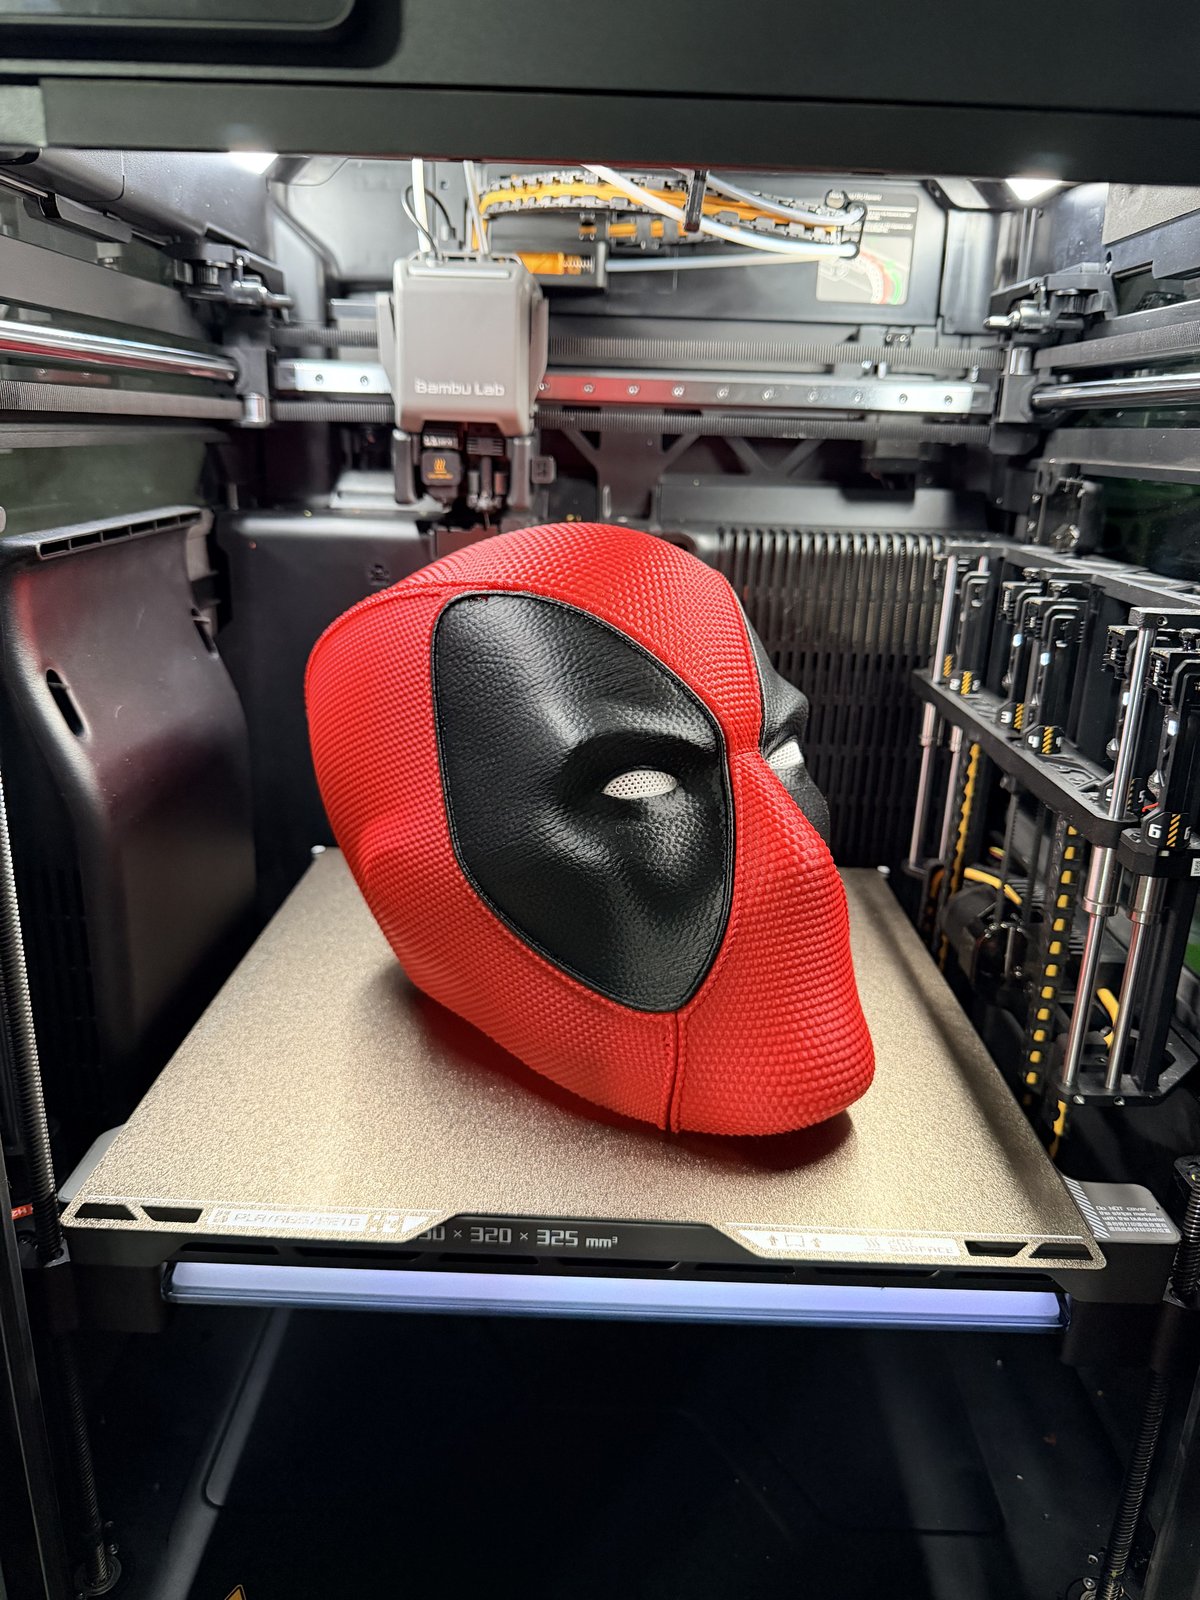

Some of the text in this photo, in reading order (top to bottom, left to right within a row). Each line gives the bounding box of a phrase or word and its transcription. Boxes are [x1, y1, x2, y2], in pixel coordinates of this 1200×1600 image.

[414, 379, 505, 396] Bambu Lab
[1000, 711, 1013, 723] 3
[1027, 735, 1040, 748] 4
[1138, 790, 1146, 803] 5
[1148, 823, 1162, 839] 6
[1183, 826, 1191, 840] 6
[470, 1226, 512, 1244] 320
[536, 1229, 579, 1246] 325
